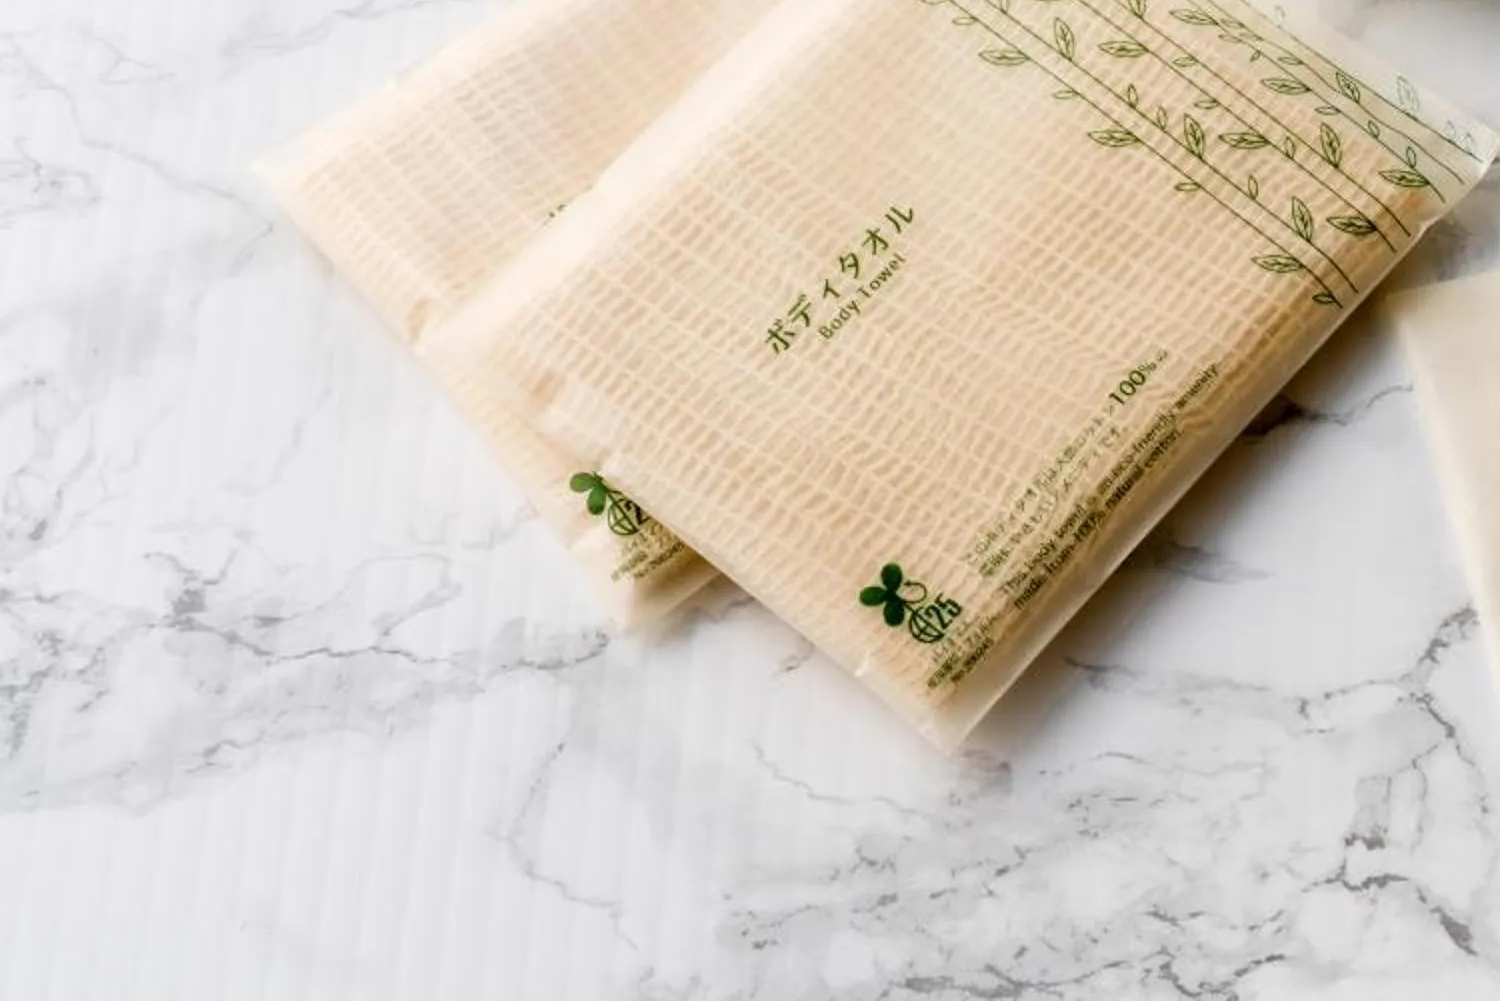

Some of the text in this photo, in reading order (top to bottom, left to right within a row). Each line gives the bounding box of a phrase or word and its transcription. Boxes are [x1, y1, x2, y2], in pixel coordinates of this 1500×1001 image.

[761, 200, 918, 353] ボディタオル
[818, 251, 906, 340] Body Towel
[926, 593, 960, 627] 25
